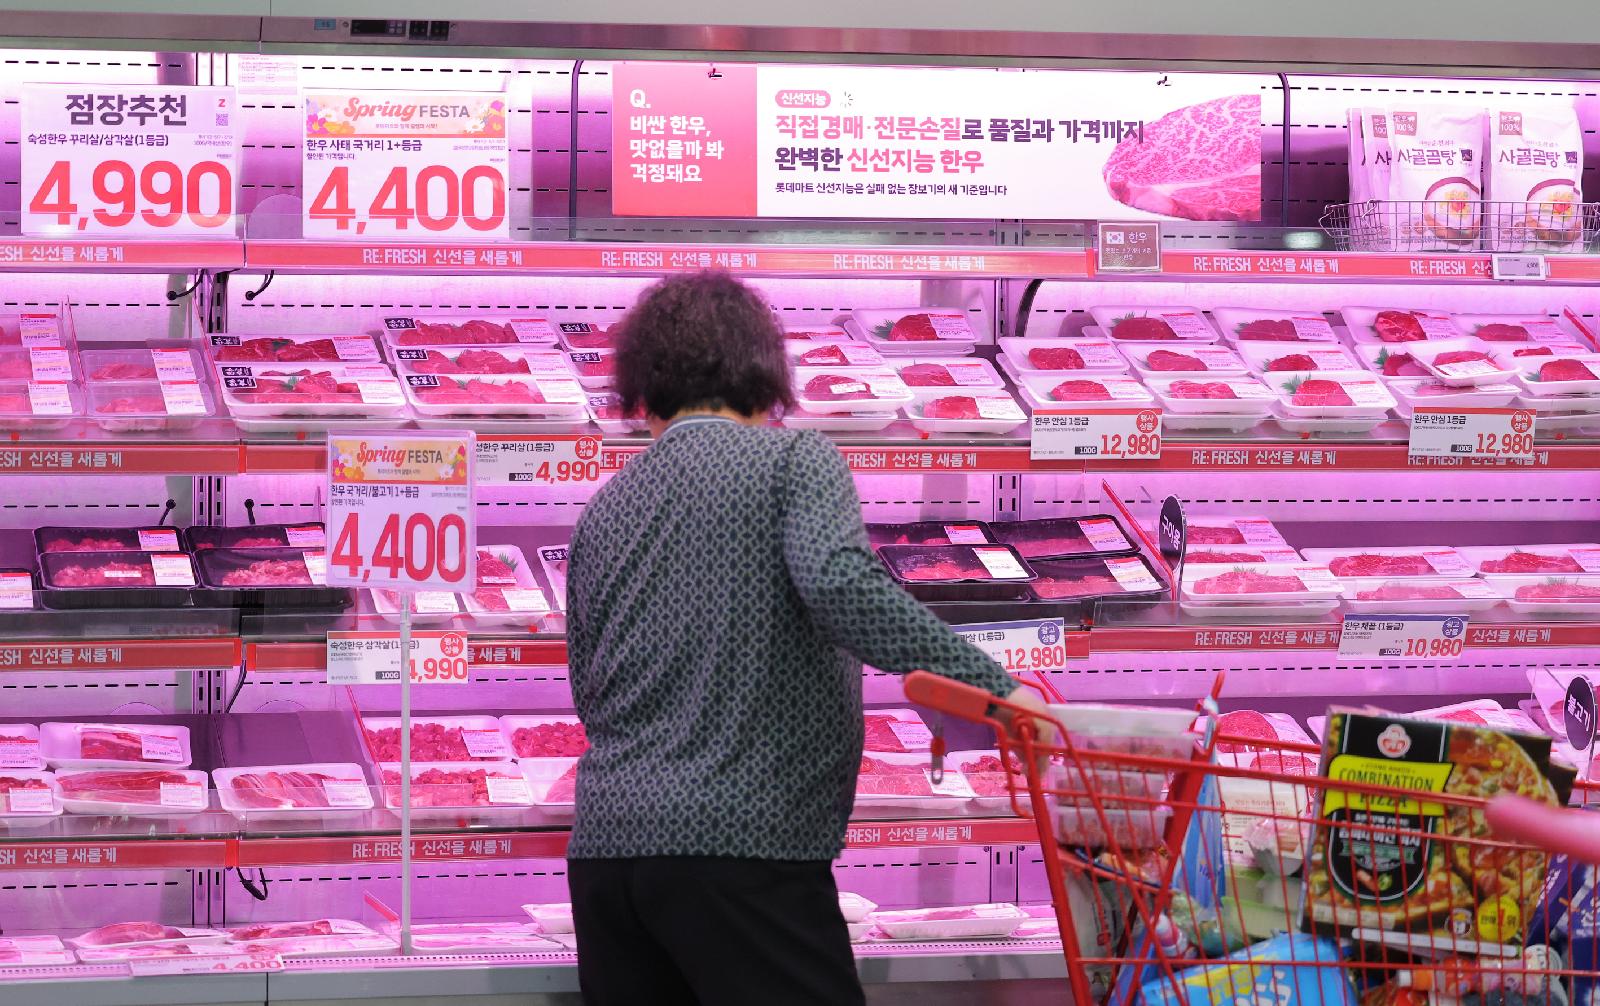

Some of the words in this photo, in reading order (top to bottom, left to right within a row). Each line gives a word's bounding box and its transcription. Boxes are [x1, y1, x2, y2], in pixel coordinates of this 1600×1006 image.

[630, 89, 651, 109] Q.
[781, 93, 826, 106] 신선지능
[65, 94, 187, 126] 점장추천
[343, 97, 417, 122] Spring
[419, 105, 470, 118] FESTA
[630, 115, 666, 135] 비싼
[669, 116, 712, 137] 한우,
[988, 118, 1054, 143] 품질과
[1058, 119, 1145, 144] 가격까지
[1396, 123, 1414, 132] 100%
[1501, 123, 1520, 132] 100%
[27, 133, 68, 145] 숙성한우
[306, 139, 328, 151] 한우
[330, 139, 351, 151] 사태
[353, 139, 384, 151] 국거리
[387, 139, 423, 152] 1+등급
[630, 139, 701, 160] 맛없을까
[705, 140, 724, 161] 봐
[1398, 148, 1457, 166] 사골곰탕
[1499, 148, 1560, 168] 사골곰탕
[775, 147, 843, 172] 완벽한
[847, 148, 935, 173] 신선지능
[940, 149, 985, 174] 한우
[631, 163, 703, 184] 걱정돼요
[29, 159, 232, 230] 4,990
[775, 183, 814, 194] 롯데마트
[816, 183, 864, 195] 신선지능은
[866, 183, 885, 195] 실패
[887, 183, 906, 195] 없는
[908, 183, 946, 196] 장보기의
[948, 184, 958, 195] 새
[960, 184, 1007, 196] 기준입니다
[309, 165, 505, 234] 4,400
[1129, 232, 1148, 244] 한우
[30, 246, 75, 260] 신선을
[80, 246, 124, 262] 새롭게
[433, 249, 476, 264] 신선을
[480, 249, 523, 266] 새롭게
[669, 252, 712, 267] 신선을
[716, 252, 758, 268] 새롭게
[900, 255, 940, 269] 신선을
[944, 256, 985, 270] 새롭게
[1257, 256, 1297, 272] 신선을
[1300, 257, 1338, 273] 새롭게
[1034, 416, 1051, 426] 한우
[1052, 416, 1067, 426] 안심
[1069, 416, 1090, 426] 1등급
[1414, 414, 1430, 424] 한우
[1431, 415, 1445, 425] 안심
[1447, 415, 1466, 425] 1등급
[476, 443, 499, 452] 성한우
[1079, 446, 1097, 454] 100G
[1100, 434, 1160, 459] 12,980
[1476, 433, 1533, 456] 12,980
[29, 451, 74, 467] 신선을
[78, 451, 122, 467] 새롭게
[357, 441, 407, 467] Spring
[408, 450, 443, 464] FESTA
[847, 453, 886, 467] FRESH
[892, 452, 933, 467] 신선을
[937, 452, 977, 467] 새롭게
[1255, 450, 1295, 465] 신선을
[1297, 449, 1336, 465] 새롭게
[514, 473, 532, 481] 100G
[535, 461, 599, 484] 4,990
[331, 485, 345, 497] 한우
[347, 485, 394, 498] 국거리/불고기
[395, 486, 420, 498] 1+등급
[1161, 515, 1182, 550] 구이용
[331, 512, 466, 583] 4,400
[1042, 625, 1056, 634] 광고
[1345, 622, 1359, 631] 한우
[1042, 634, 1056, 643] 상품
[1259, 631, 1297, 645] 신선을
[1301, 630, 1339, 644] 새롭게
[1473, 629, 1510, 643] 신선을
[1513, 628, 1551, 643] 새롭게
[330, 641, 364, 650] 숙성한우
[366, 640, 420, 650] 삼각살(1급)
[1404, 638, 1463, 659] 10,980
[29, 649, 73, 664] 신선을
[78, 648, 122, 664] 새롭게
[479, 647, 521, 662] 새롭게
[1004, 645, 1064, 670] 12,980
[381, 672, 399, 680] 100G
[1567, 694, 1591, 732] 불고기
[1340, 768, 1434, 791] COMBINATION
[887, 826, 928, 842] 신선을
[931, 825, 972, 841] 새롭게
[24, 848, 68, 865] 신선을
[72, 847, 117, 864] 새롭게
[422, 841, 465, 857] 신선을
[469, 839, 512, 855] 새롭게
